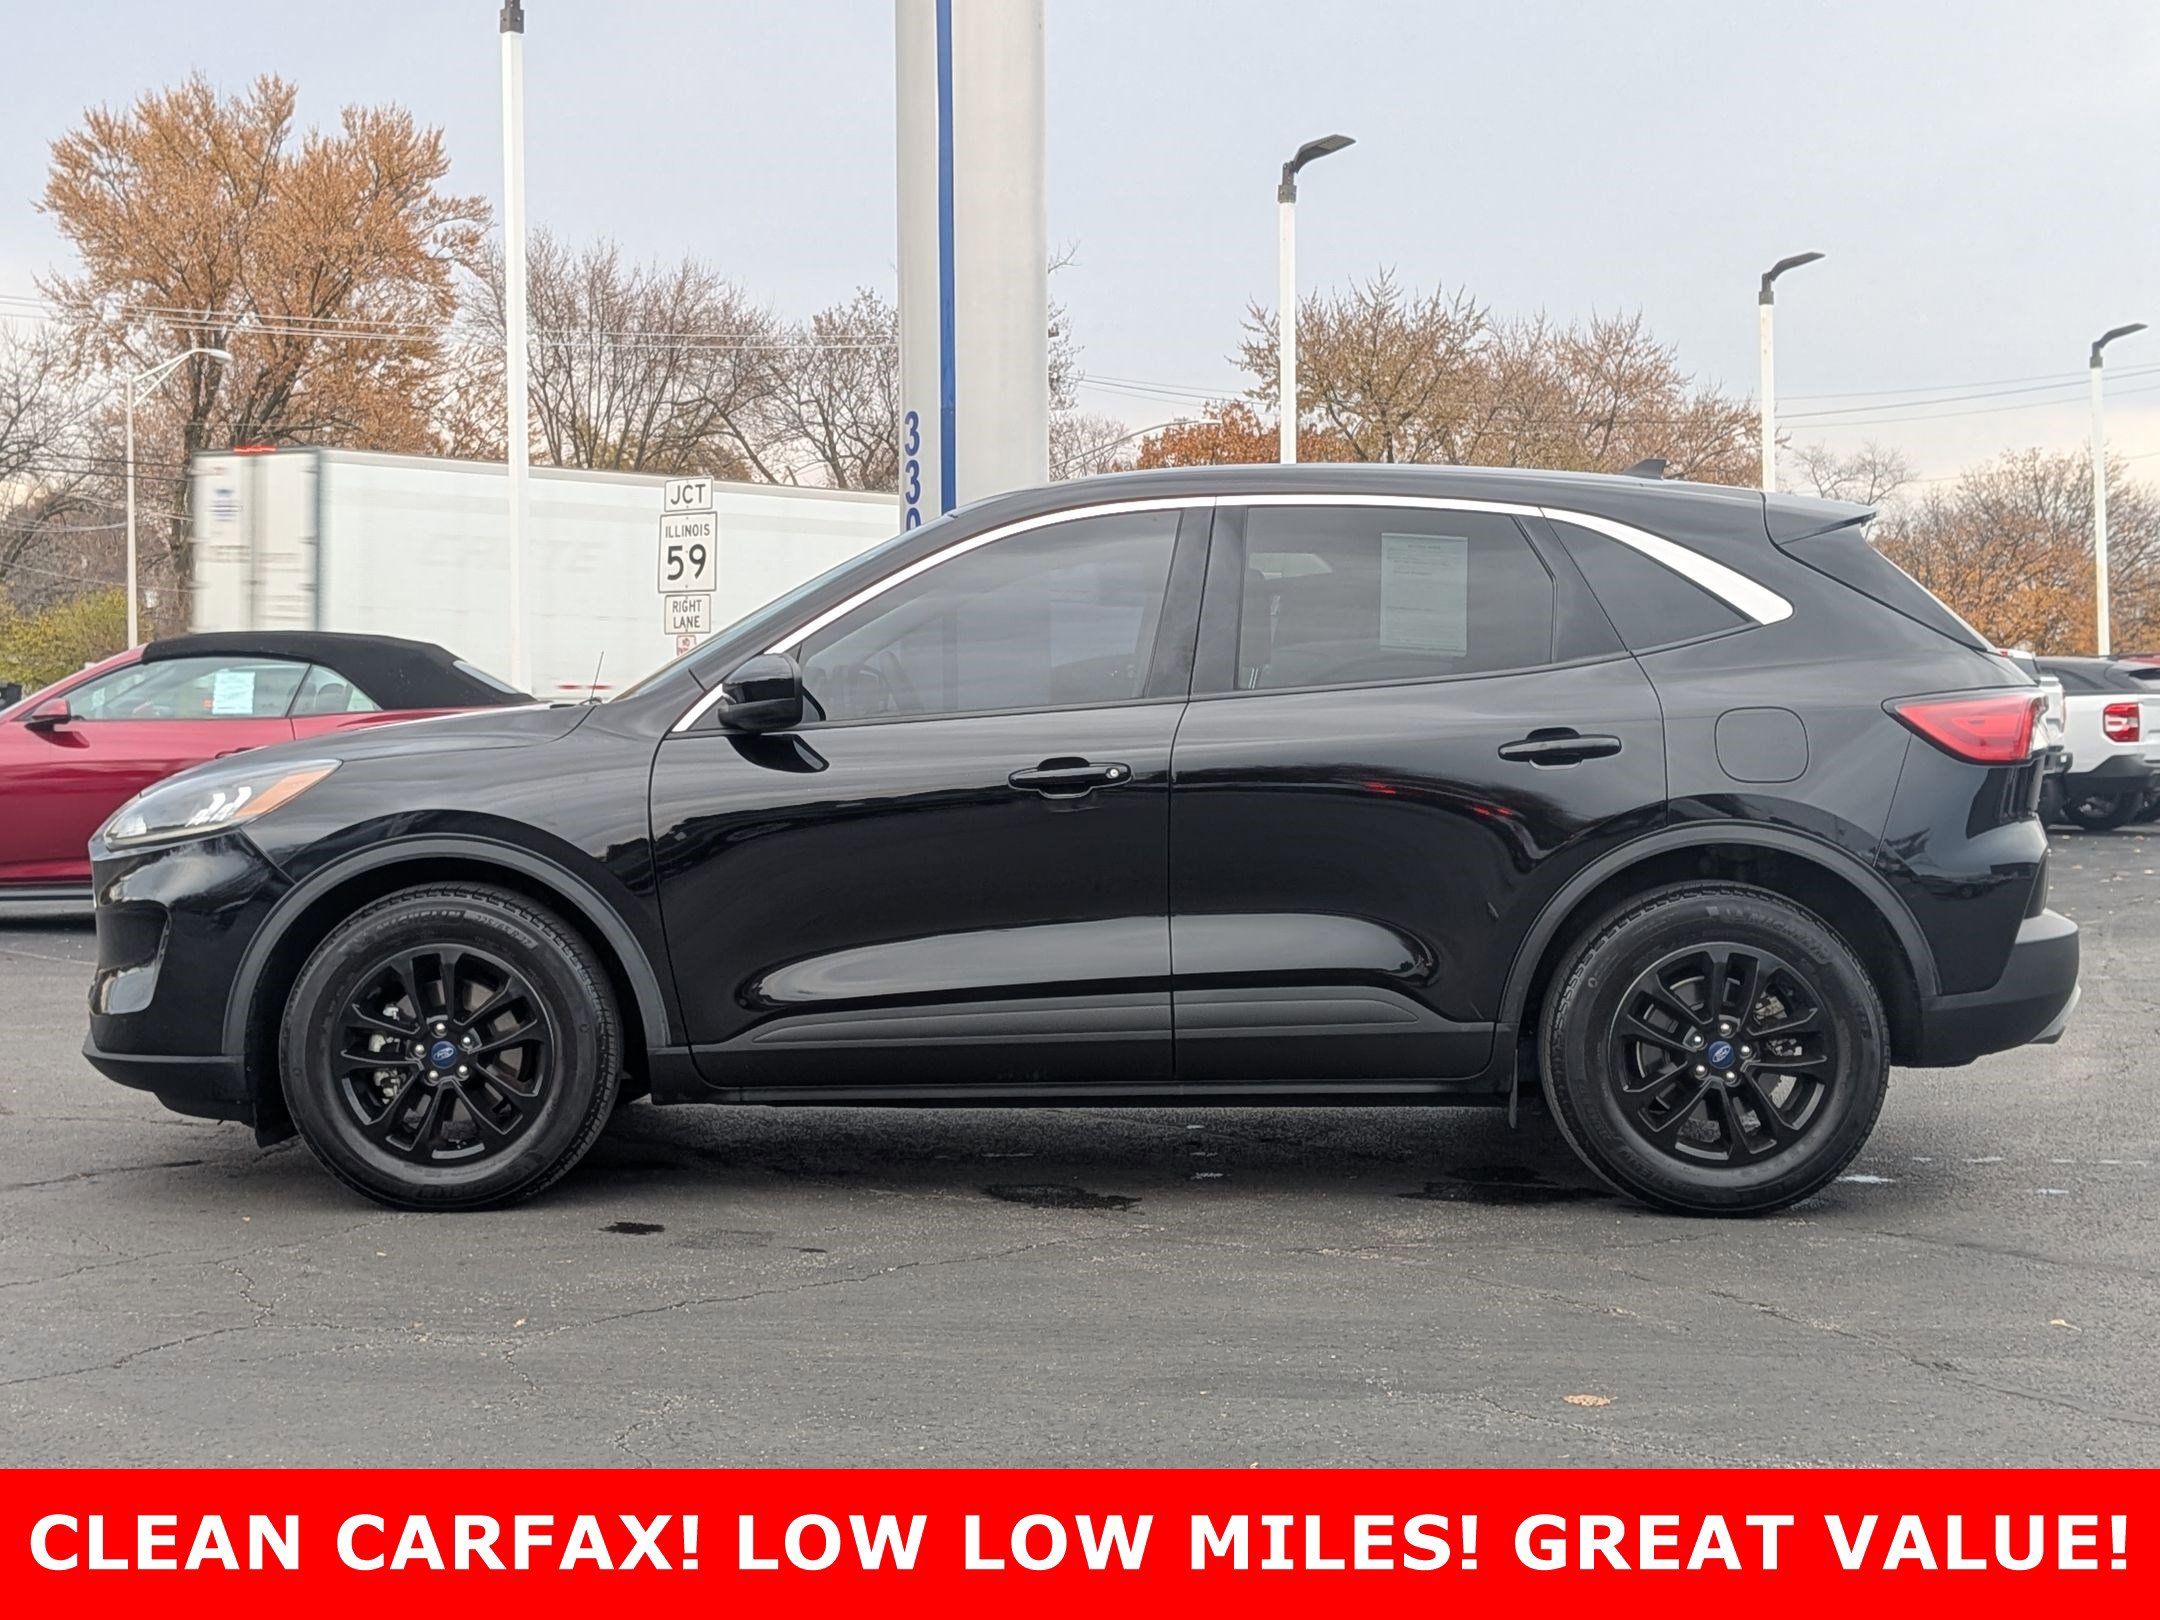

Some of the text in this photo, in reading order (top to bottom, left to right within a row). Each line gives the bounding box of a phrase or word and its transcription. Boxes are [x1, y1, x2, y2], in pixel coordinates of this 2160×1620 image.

[670, 483, 706, 505] JCT
[665, 523, 711, 539] ILLINOIS
[667, 543, 707, 581] 59
[672, 599, 702, 613] RIGHT
[673, 615, 701, 630] LANE
